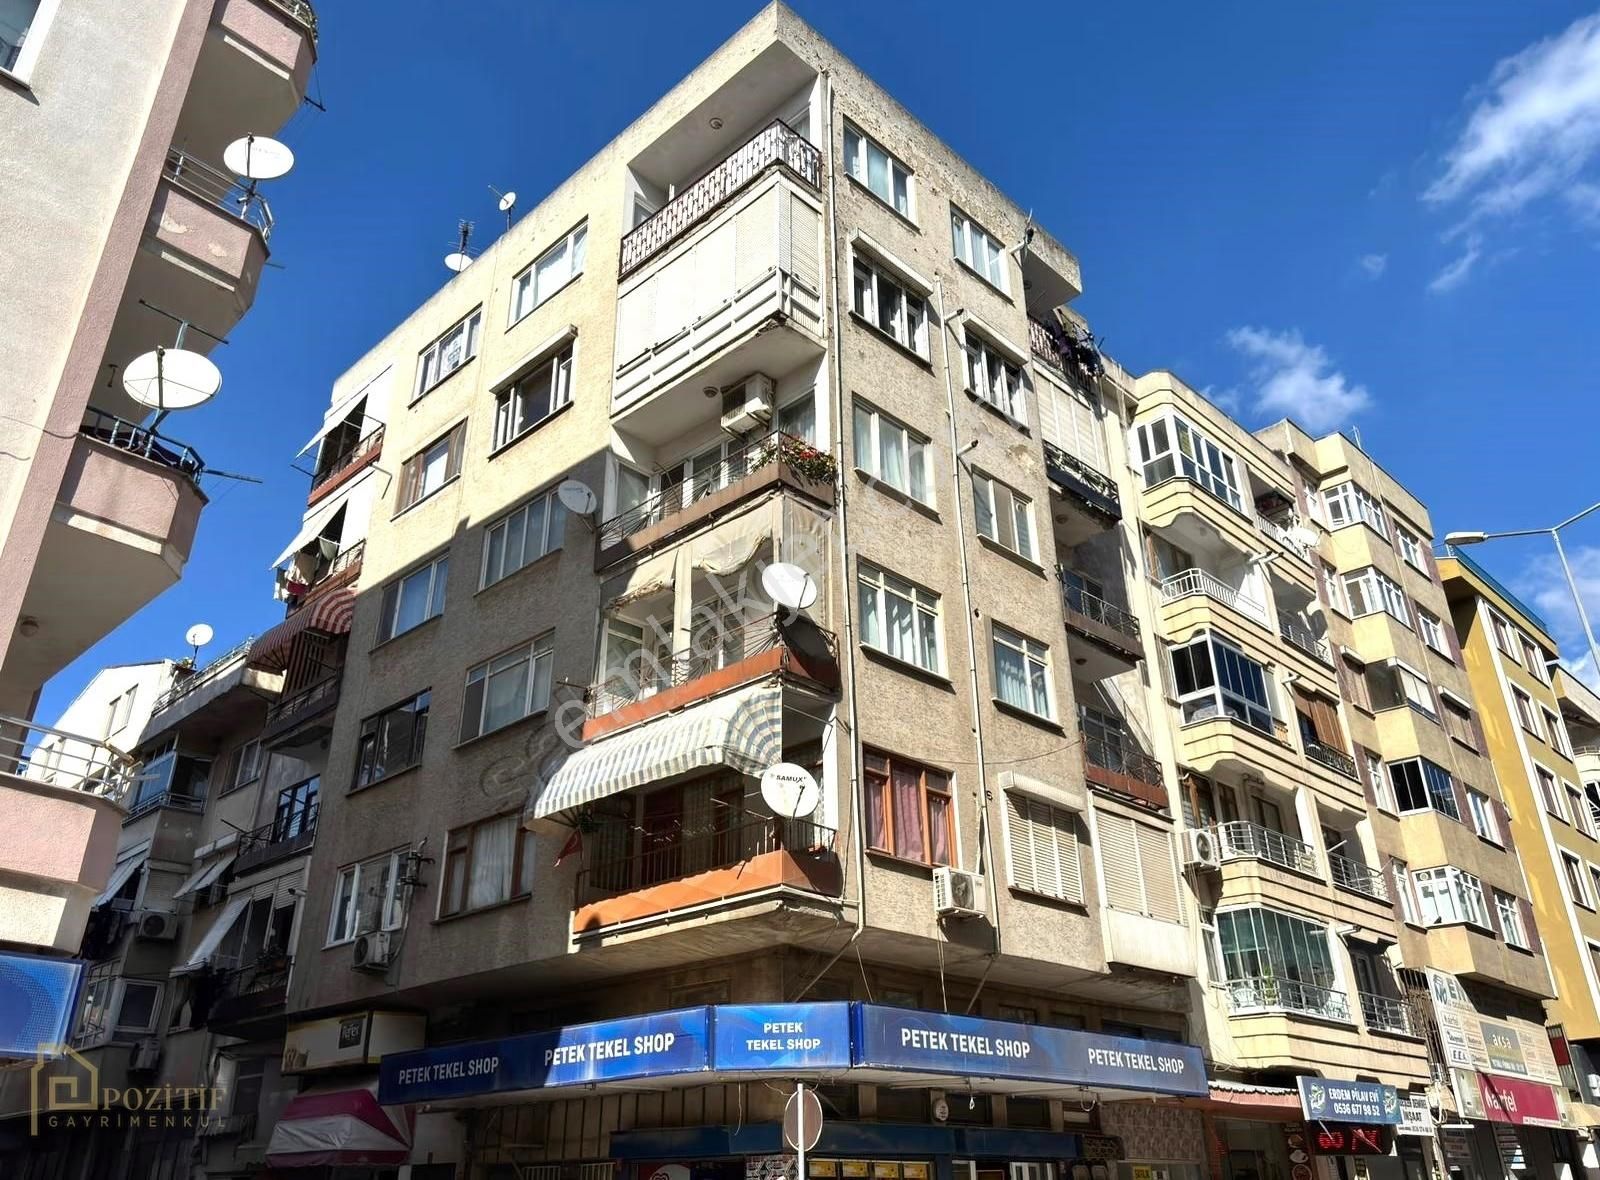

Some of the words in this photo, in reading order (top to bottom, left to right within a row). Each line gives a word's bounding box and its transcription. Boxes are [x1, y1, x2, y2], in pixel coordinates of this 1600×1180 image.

[763, 1022, 803, 1034] PETEK
[544, 1044, 586, 1067] PETEK
[587, 1038, 632, 1060] TEKEL
[634, 1032, 676, 1054] SHOP
[745, 1039, 785, 1051] TEKEL
[786, 1038, 821, 1050] SHOP
[900, 1027, 949, 1051] PETEK
[950, 1033, 994, 1056] TEKEL
[996, 1039, 1031, 1059] SHOP
[398, 1064, 433, 1085] PETEK
[432, 1060, 467, 1081] TEKEL
[468, 1055, 500, 1077] SHOP
[1088, 1047, 1125, 1068] PETEK
[1125, 1052, 1159, 1072] TEKEL
[1159, 1056, 1185, 1075] SHOP
[1328, 1087, 1352, 1101] ERDEM
[1352, 1088, 1370, 1102] PİLAV
[1369, 1089, 1380, 1102] EVİ
[1333, 1103, 1351, 1115] 0536
[1362, 1105, 1372, 1116] 98
[1372, 1106, 1381, 1116] 52
